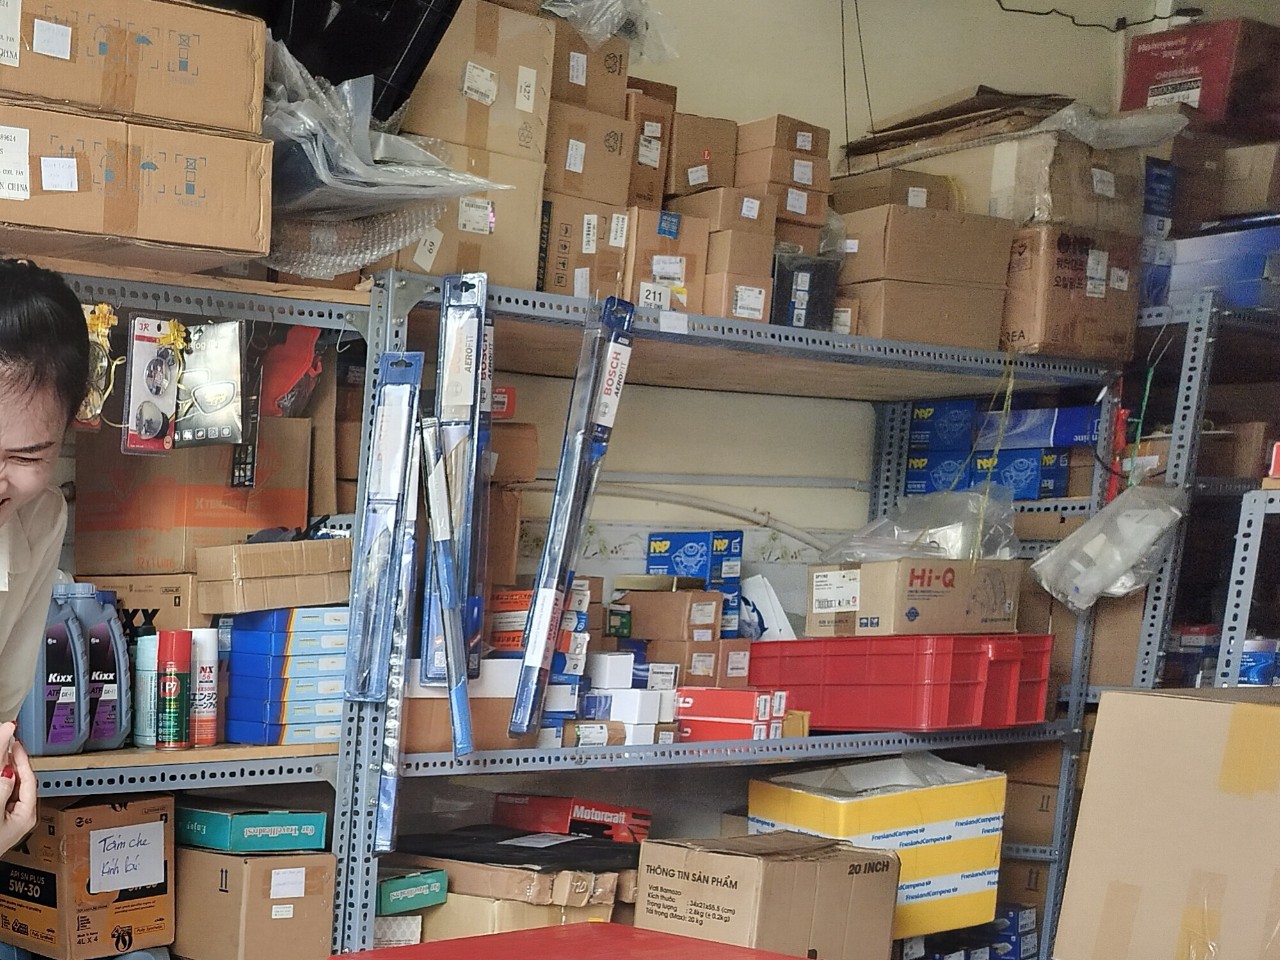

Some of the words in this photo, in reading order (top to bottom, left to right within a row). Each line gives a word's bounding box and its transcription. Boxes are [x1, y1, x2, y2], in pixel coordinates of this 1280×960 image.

[7, 182, 29, 192] CHINA
[645, 288, 663, 303] 211
[464, 333, 475, 374] AEROFIT
[603, 351, 621, 396] BOSCH
[614, 361, 627, 399] AEROFIT
[909, 567, 956, 588] Hi-Q
[91, 671, 116, 681] Kixx
[200, 665, 214, 674] NX
[47, 672, 74, 683] Kixx
[165, 682, 178, 693] P7
[572, 804, 625, 825] Motorcraft
[300, 825, 316, 836] Car
[871, 828, 919, 841] FrieslandCampina
[128, 832, 151, 848] che
[898, 835, 946, 848] FrieslandCampina
[847, 862, 862, 876] 20
[863, 861, 890, 874] INCH
[9, 869, 20, 879] API
[20, 873, 29, 881] SN
[29, 875, 45, 885] PLUS
[645, 864, 676, 878] THÔNG
[677, 870, 690, 880] TIN
[691, 870, 710, 885] SẢN
[711, 874, 738, 890] PHẨM
[8, 879, 41, 898] 5W-30
[905, 888, 952, 901] FrieslandCampina
[721, 906, 736, 915] (cm)
[77, 937, 86, 945] 4L
